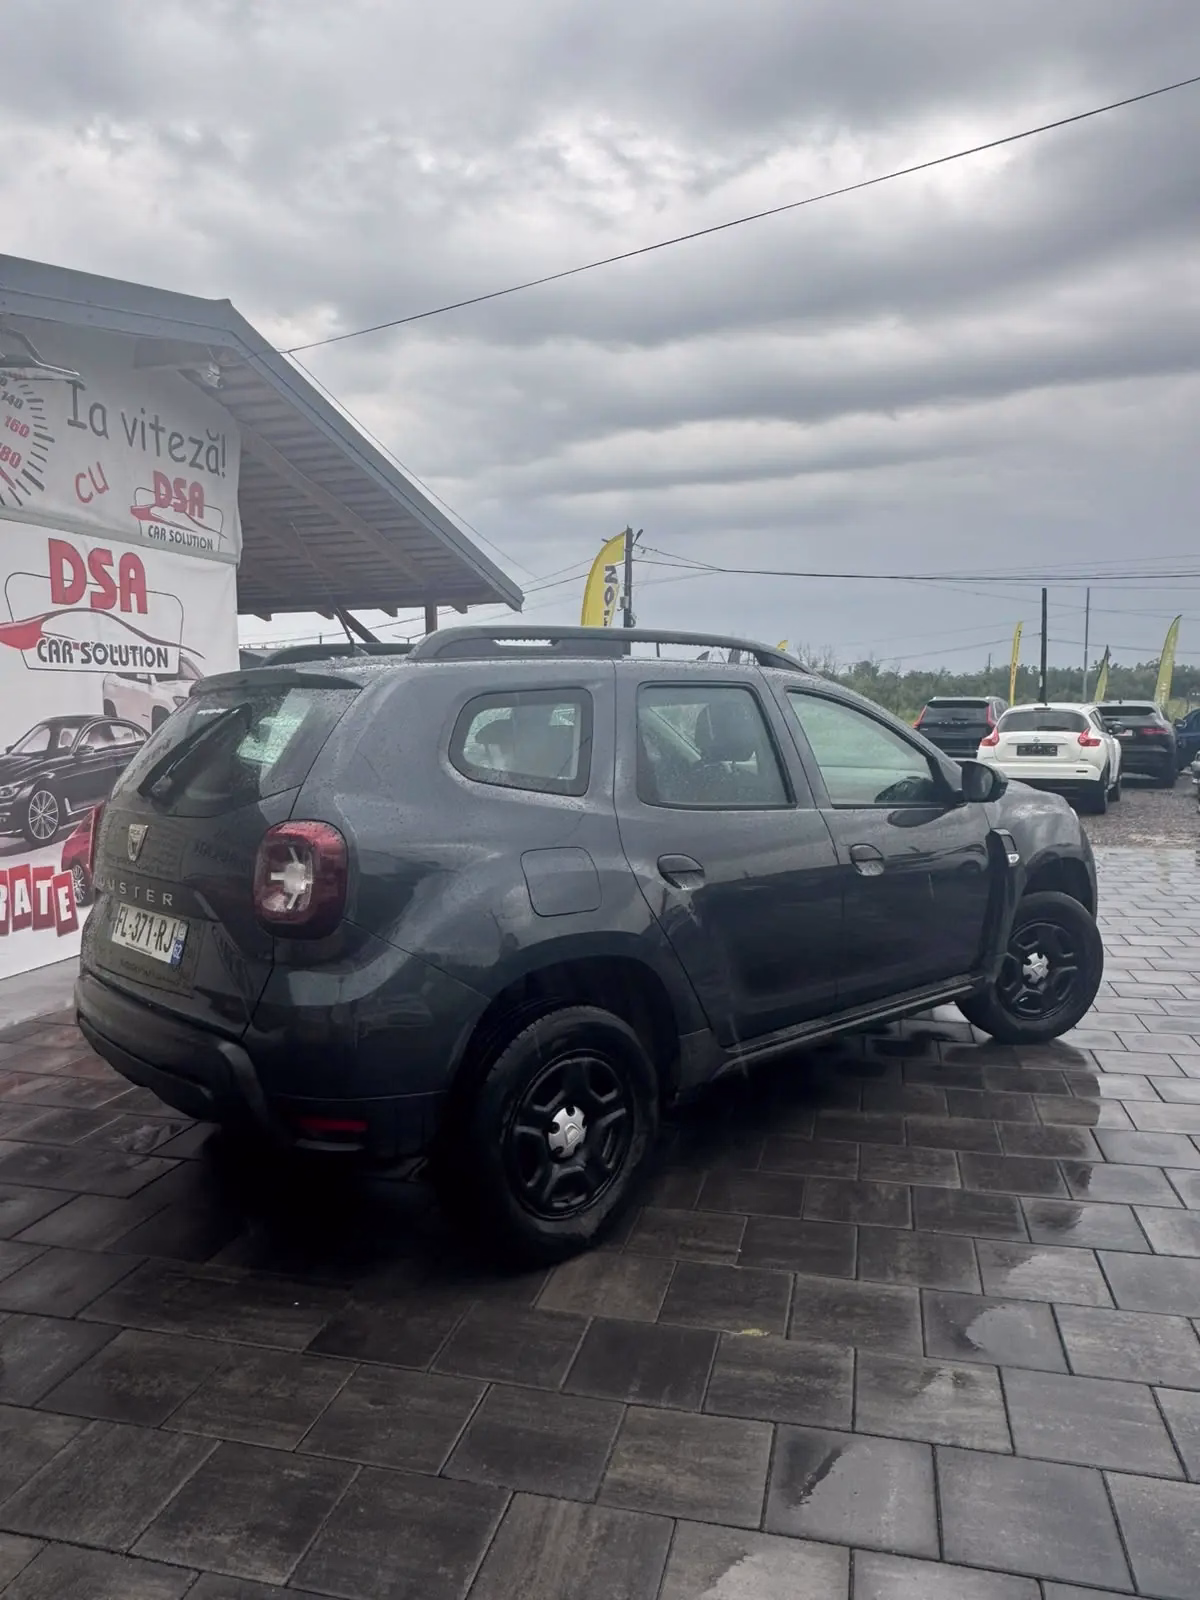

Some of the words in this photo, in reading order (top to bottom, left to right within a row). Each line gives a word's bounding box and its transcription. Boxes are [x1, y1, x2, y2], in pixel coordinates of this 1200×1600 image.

[4, 415, 30, 438] 160
[121, 407, 226, 479] viteză!
[153, 470, 204, 519] DSA
[148, 525, 167, 542] CAR
[168, 530, 213, 550] SOLUTION
[48, 538, 148, 614] DSA
[37, 639, 74, 664] CAR
[80, 641, 168, 668] SOLUTION
